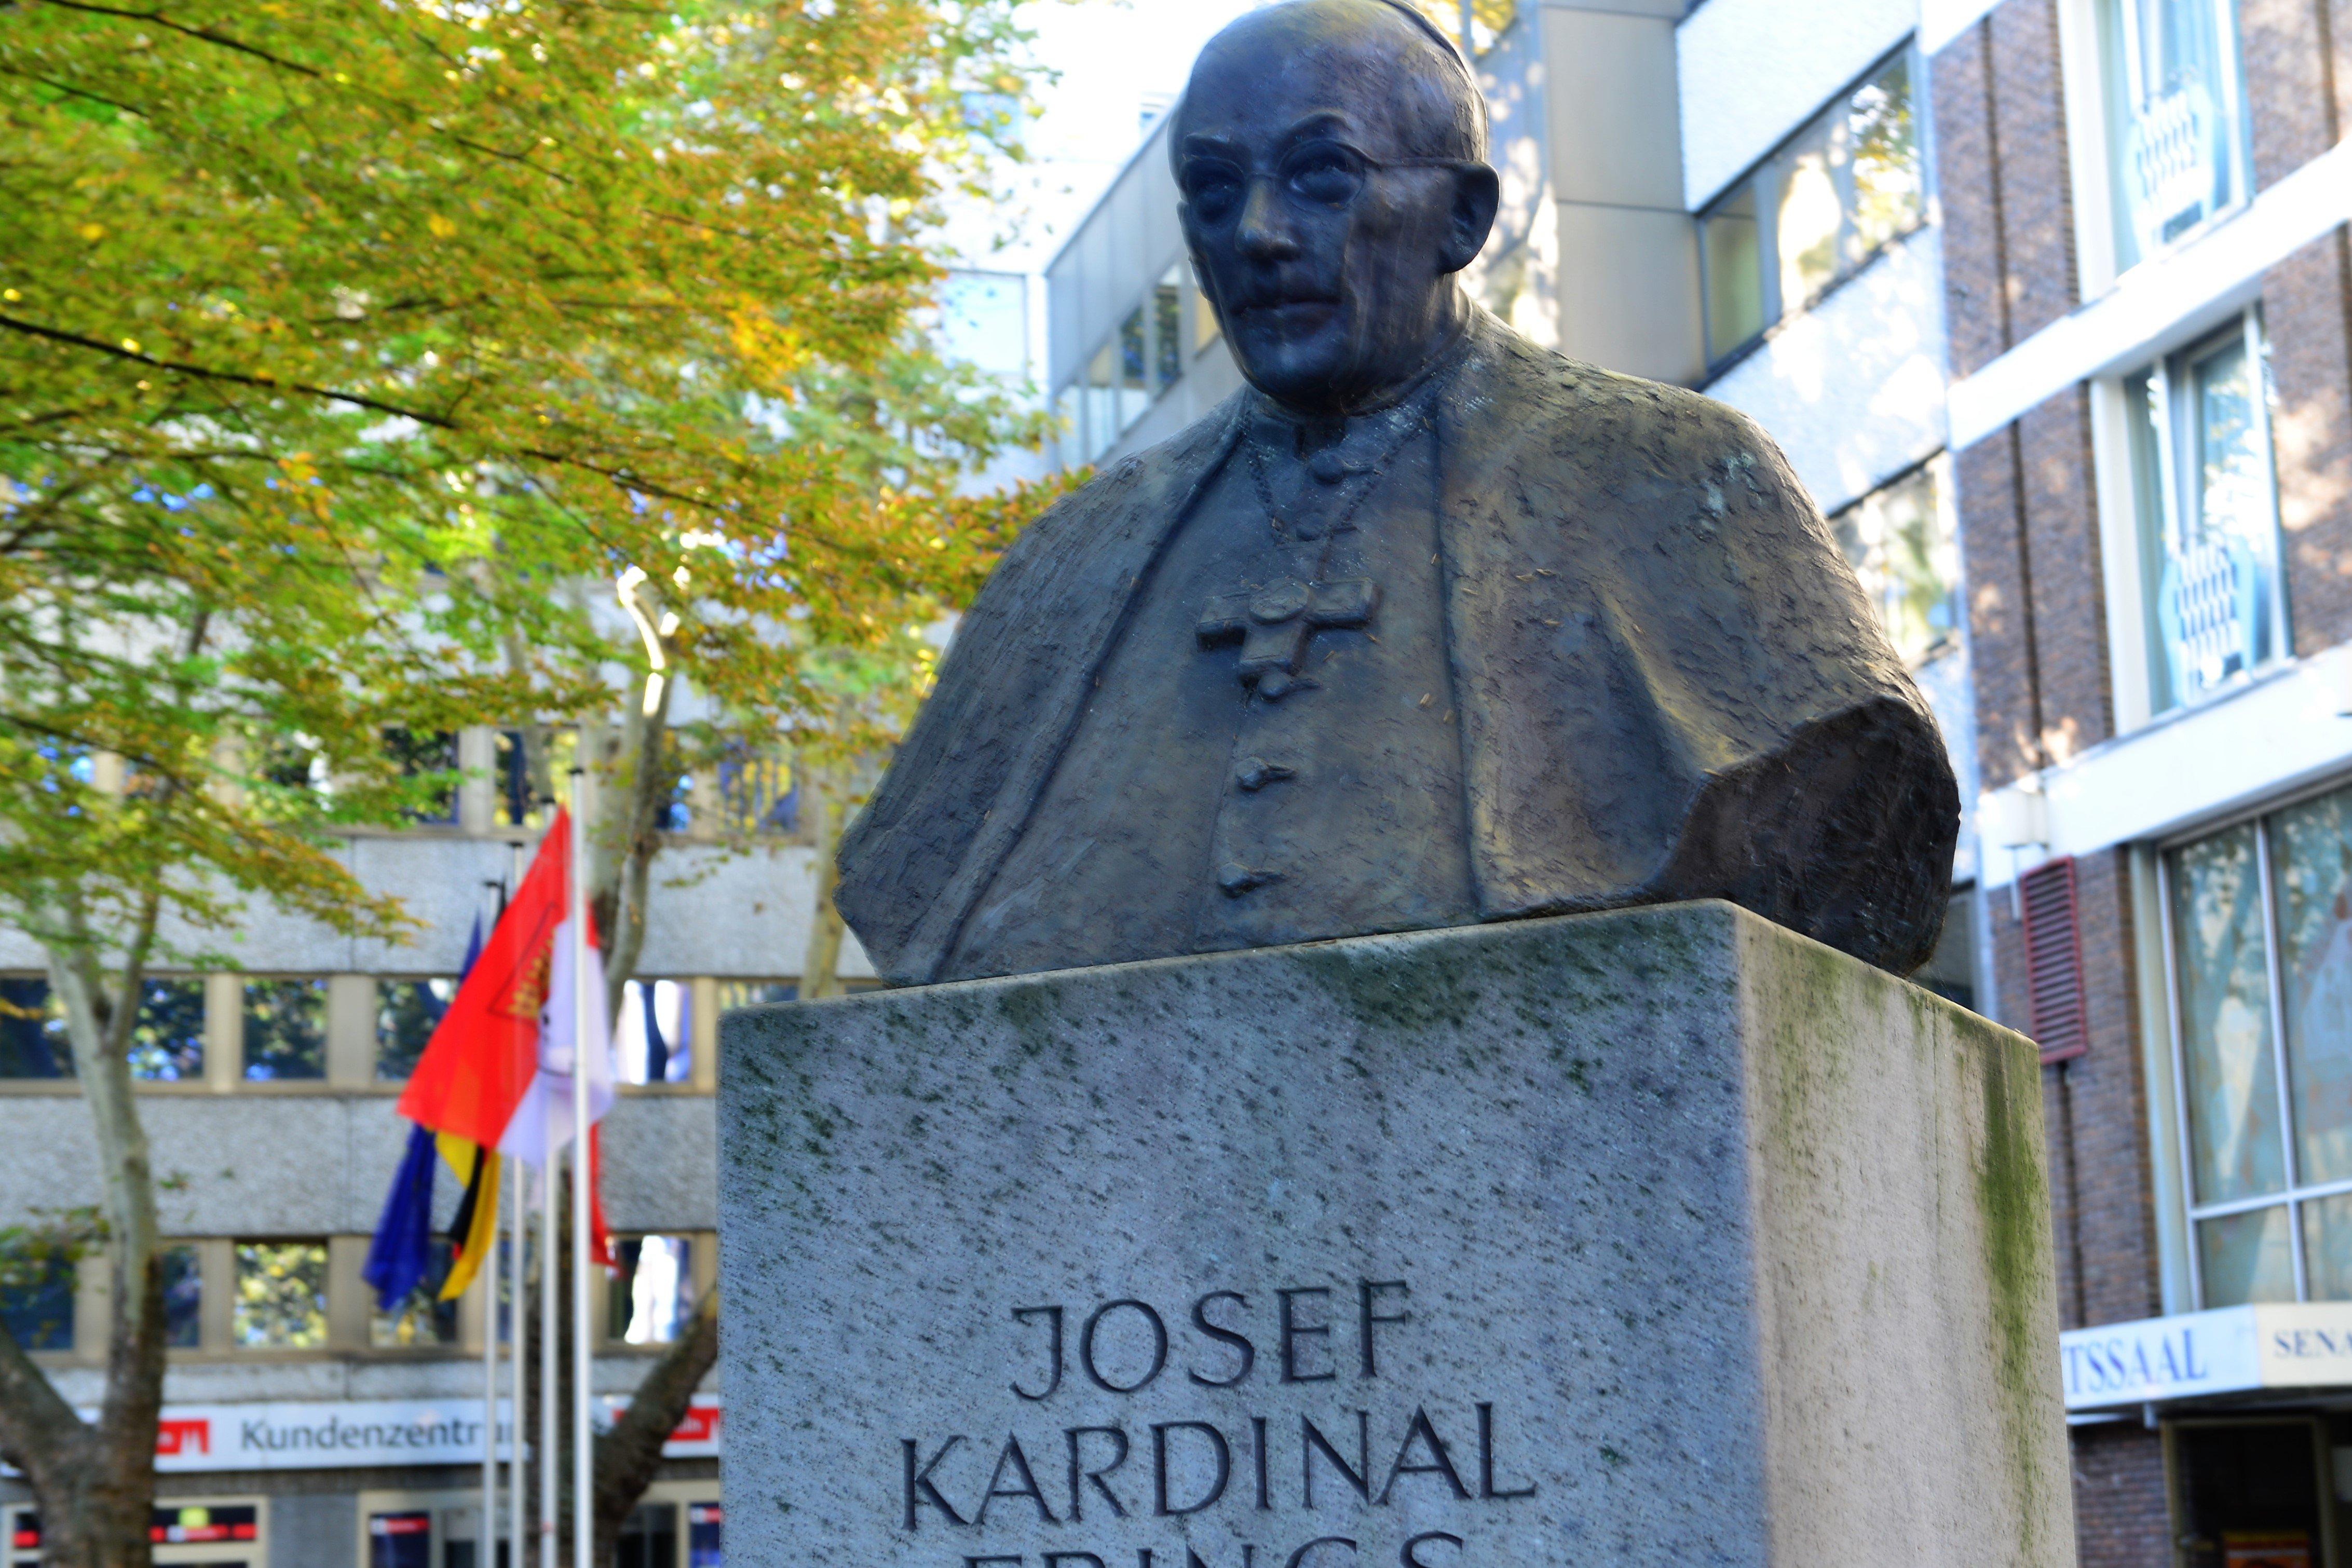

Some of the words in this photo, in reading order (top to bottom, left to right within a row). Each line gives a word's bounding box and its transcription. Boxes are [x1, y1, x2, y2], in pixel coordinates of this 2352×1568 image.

[1010, 1279, 1408, 1400] JOSEF
[2062, 1329, 2209, 1395] TSSAAL
[240, 1414, 513, 1450] Kundenzentr
[901, 1401, 1537, 1531] KARDINAL
